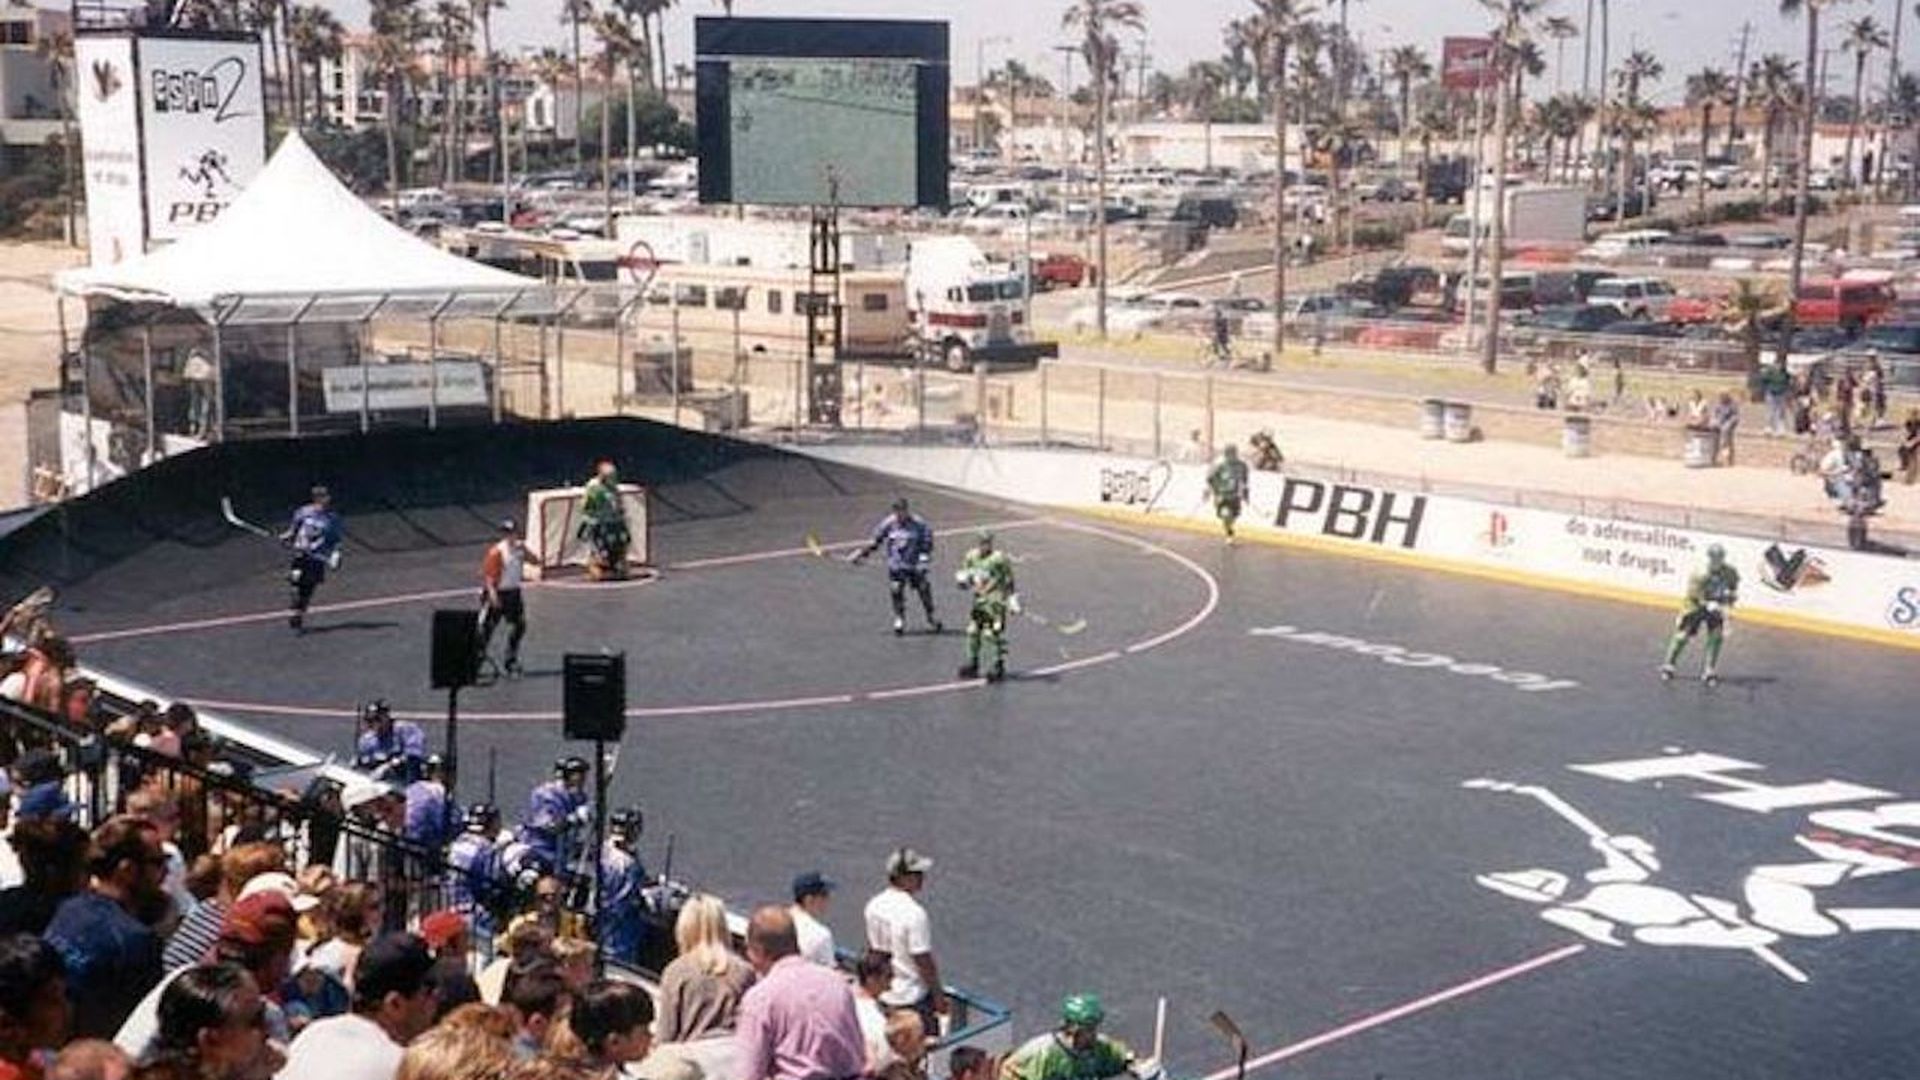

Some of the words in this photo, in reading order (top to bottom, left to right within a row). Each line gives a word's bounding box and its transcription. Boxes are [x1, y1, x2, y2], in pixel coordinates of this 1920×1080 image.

[170, 201, 231, 223] PB
[1275, 477, 1428, 549] PBH
[1566, 517, 1587, 536] do
[1582, 548, 1612, 566] not
